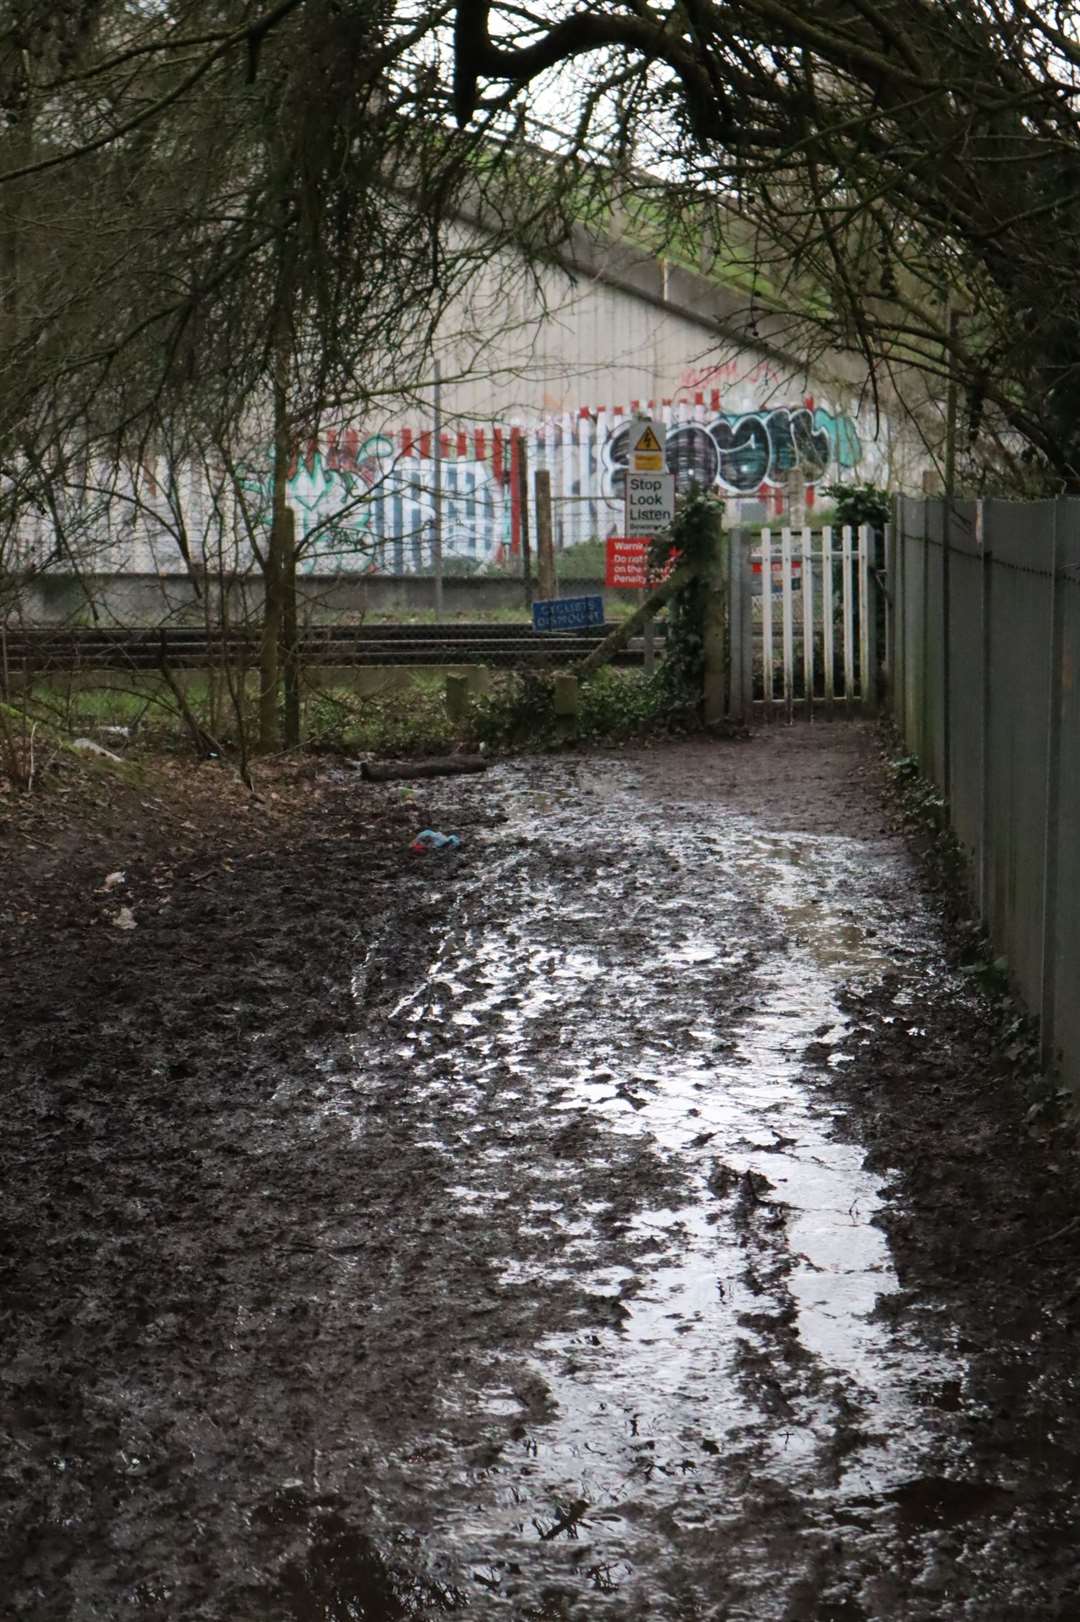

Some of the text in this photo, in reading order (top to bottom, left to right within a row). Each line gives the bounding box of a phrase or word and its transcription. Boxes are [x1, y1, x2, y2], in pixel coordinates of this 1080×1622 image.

[630, 479, 662, 492] Stop
[630, 494, 662, 505] Look
[630, 509, 671, 520] Listen
[614, 555, 625, 563] Do
[628, 555, 643, 563] not
[614, 575, 646, 584] Penalty
